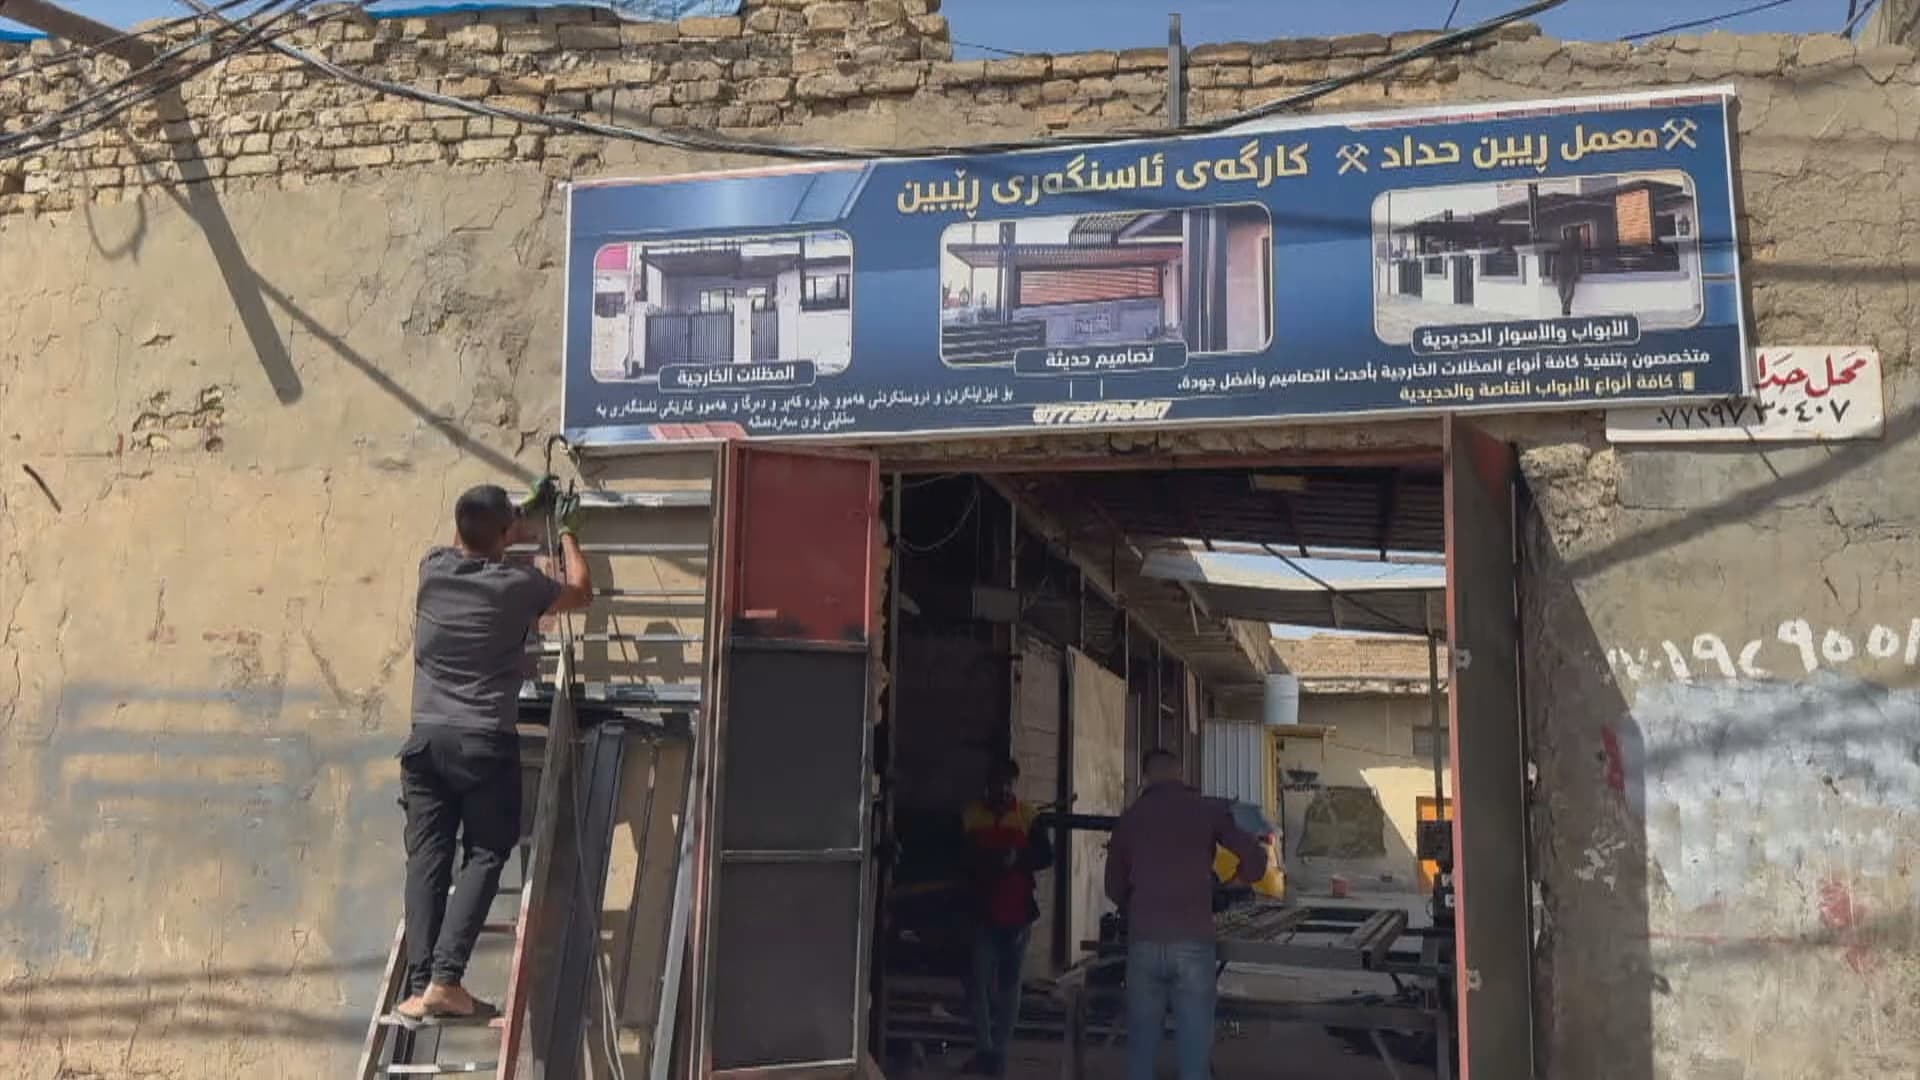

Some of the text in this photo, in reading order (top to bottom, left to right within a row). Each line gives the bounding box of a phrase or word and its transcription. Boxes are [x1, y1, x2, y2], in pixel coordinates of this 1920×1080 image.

[1381, 134, 1460, 169] حداد
[1560, 124, 1658, 161] معمل
[1422, 320, 1629, 351] الأبواب والأسوار الحديدية
[1044, 347, 1154, 370] تصاميم حديثة
[1441, 358, 1503, 375] المظلات
[1508, 355, 1541, 374] أنواع
[1544, 354, 1578, 369] كافة
[1583, 352, 1628, 371] بتنفيذ
[1631, 350, 1710, 371] متخصصون
[676, 364, 796, 389] المظلات الخارجية
[1269, 368, 1331, 388] التصاميم
[1334, 364, 1377, 384] بأحدث
[1381, 361, 1437, 381] الخارجية
[1754, 351, 1867, 398] محل حدا
[1220, 371, 1266, 392] وأفضل
[1536, 377, 1591, 397] الأبواب
[1595, 372, 1632, 392] أنواع
[1636, 373, 1674, 390] كافة
[1399, 384, 1475, 402] والحديدية
